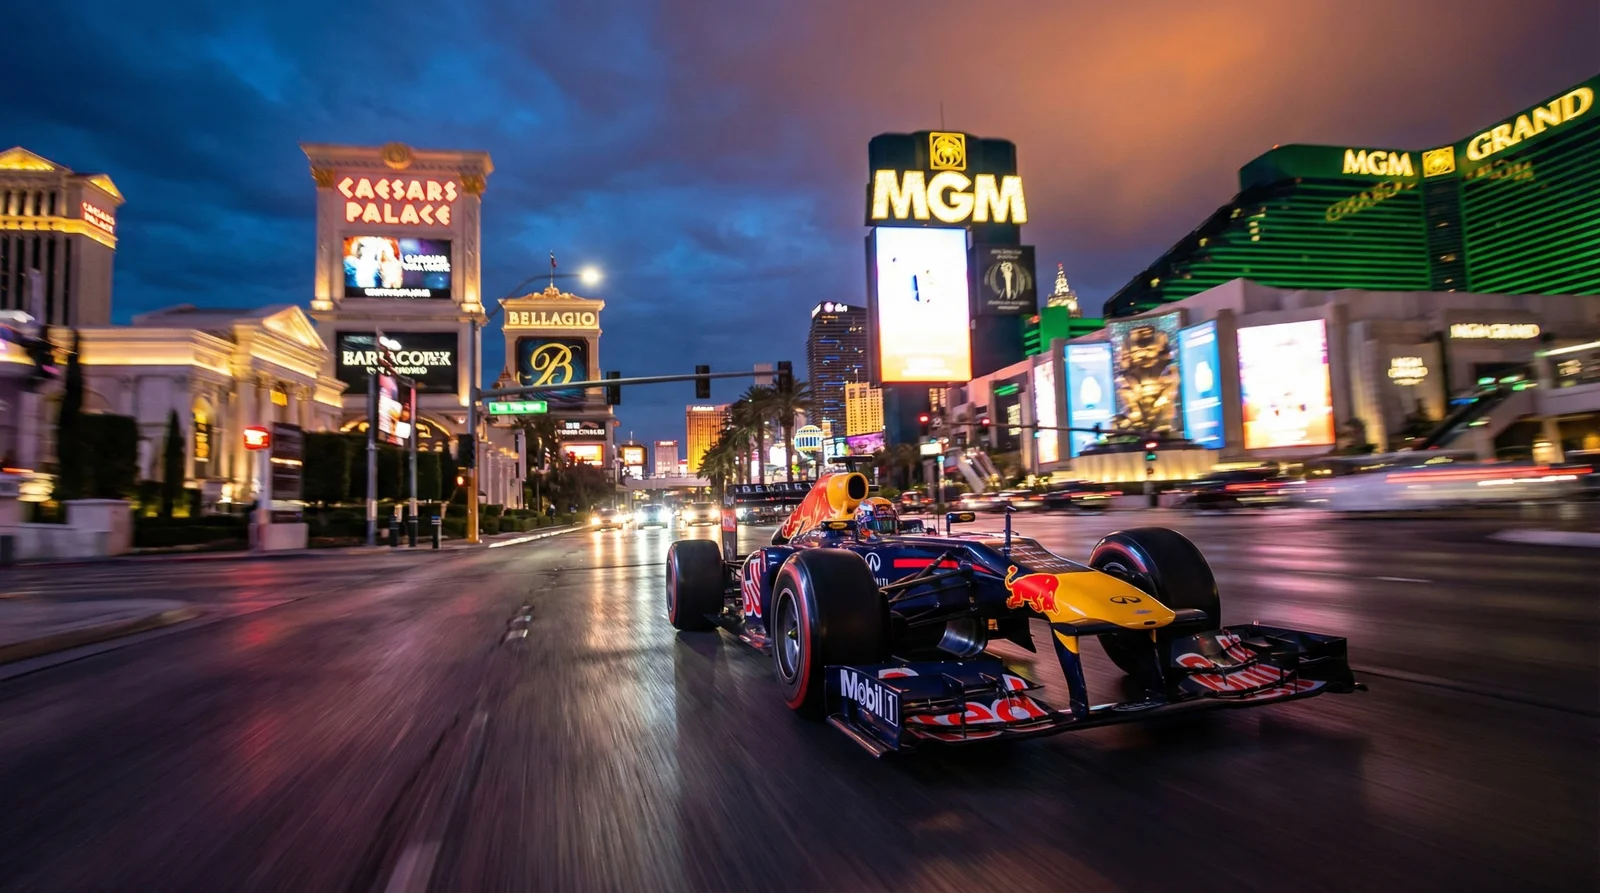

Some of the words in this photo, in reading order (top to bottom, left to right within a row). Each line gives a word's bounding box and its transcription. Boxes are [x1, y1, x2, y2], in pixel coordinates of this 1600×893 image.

[1342, 149, 1414, 176] MGM
[1466, 87, 1594, 161] GRAND
[338, 177, 458, 202] CAESARS
[872, 169, 1027, 224] MGM
[345, 201, 451, 226] PALACE
[508, 311, 595, 325] BELLAGIO
[840, 668, 883, 718] Mobil
